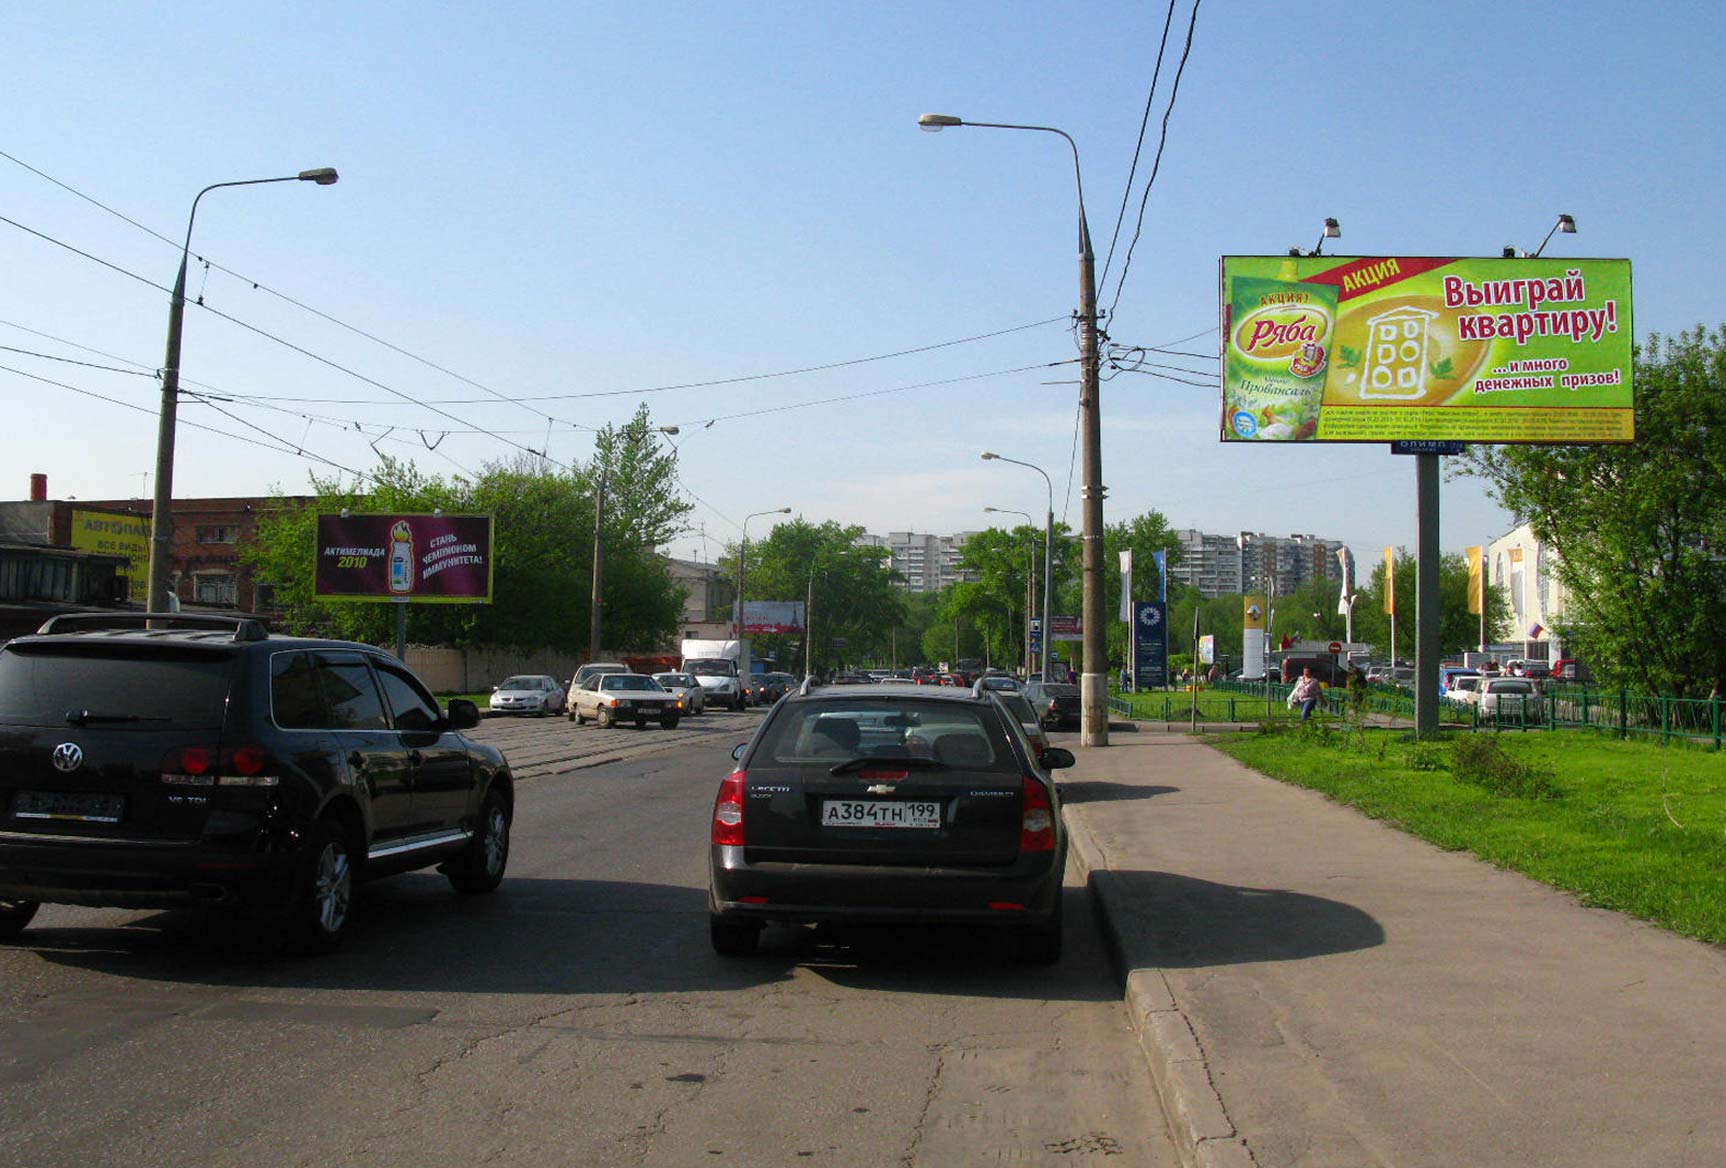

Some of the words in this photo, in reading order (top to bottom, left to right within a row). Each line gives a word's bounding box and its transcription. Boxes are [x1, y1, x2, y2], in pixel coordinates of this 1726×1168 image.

[1343, 258, 1401, 292] АКЦИЯ
[1260, 292, 1311, 306] АКЦИЯ!
[1443, 270, 1585, 310] Выиграй
[1458, 301, 1618, 345] квартиру!
[1246, 314, 1317, 352] Ряба
[1522, 358, 1568, 372] много
[1239, 380, 1312, 396] Провансаль
[1474, 375, 1554, 393] денежных
[1561, 370, 1621, 390] призов!
[430, 533, 457, 548] СТАНЬ
[324, 547, 385, 558] АКТИМЕЛИАДА
[422, 544, 477, 564] ЧЕМПИОНОМ
[337, 556, 369, 569] 2010
[422, 555, 483, 580] ИММУНИТЕТА!
[907, 803, 936, 818] 199
